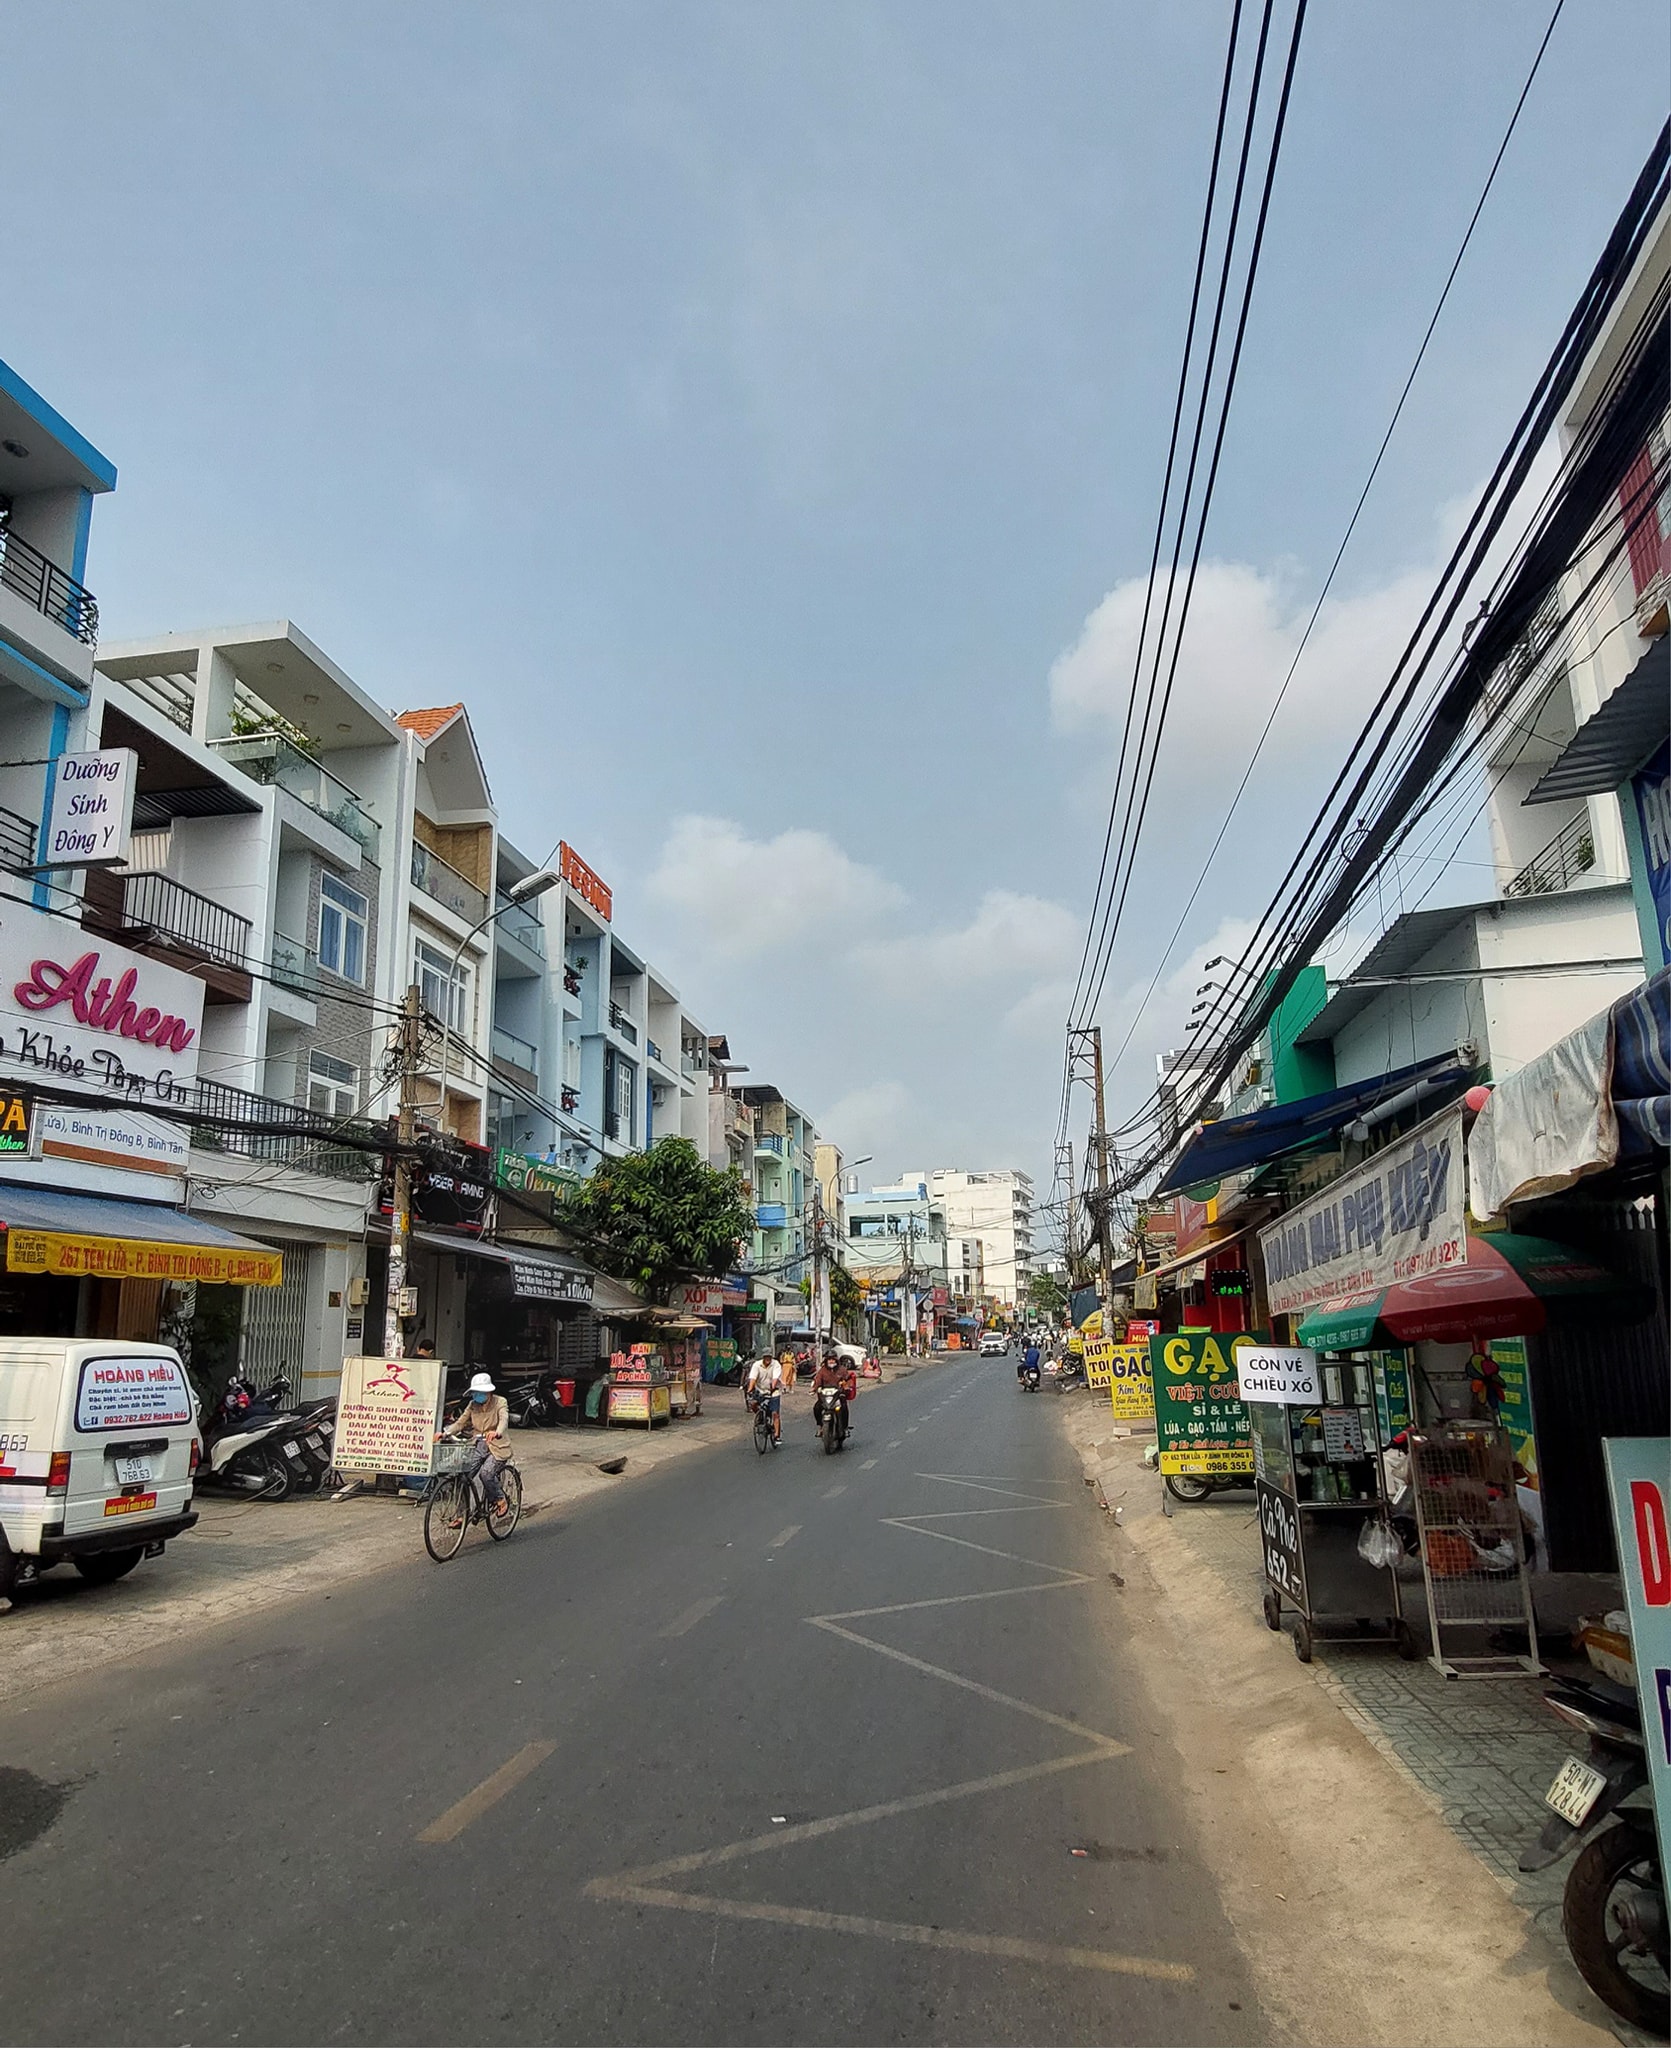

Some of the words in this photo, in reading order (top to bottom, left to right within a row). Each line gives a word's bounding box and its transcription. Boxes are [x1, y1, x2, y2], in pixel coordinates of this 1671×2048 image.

[62, 758, 120, 781] Dưỡng
[67, 792, 108, 816] Sinh
[54, 829, 96, 854] Đông
[103, 825, 114, 848] Y
[14, 951, 195, 1053] Athen
[17, 1027, 85, 1078] Khỏe
[93, 1049, 146, 1094] Tâm
[45, 1115, 67, 1133] ửa),
[72, 1121, 93, 1138] Bình
[95, 1125, 107, 1141] Trị
[110, 1128, 134, 1146] Đông
[136, 1133, 144, 1148] B,
[148, 1137, 167, 1152] Bình
[168, 1141, 184, 1155] Tân
[1265, 1223, 1310, 1286] HOÀNG
[1309, 1202, 1342, 1267] MAI
[1342, 1177, 1385, 1257] PHỤ
[1387, 1137, 1451, 1242] KIỆN
[59, 1245, 80, 1268] 267
[136, 1251, 144, 1272] P.
[214, 1258, 220, 1276] B
[684, 1284, 707, 1304] XÔI
[1085, 1341, 1110, 1357] HỚT
[1089, 1358, 1109, 1373] TÓ
[1249, 1355, 1281, 1371] CÒN
[1285, 1357, 1303, 1372] VÉ
[94, 1366, 145, 1384] HOÀNG
[1244, 1375, 1287, 1391] CHIỀU
[1117, 1383, 1135, 1395] Kim
[1166, 1382, 1205, 1403] VIỆT
[376, 1406, 397, 1414] SINH
[400, 1407, 425, 1416] ĐÔNG
[1193, 1402, 1206, 1416] SỈ
[1210, 1405, 1220, 1415] &
[1225, 1401, 1242, 1415] LẺ
[341, 1412, 356, 1420] GỘI
[412, 1417, 433, 1425] SINH
[349, 1421, 367, 1429] ĐAU
[406, 1424, 424, 1433] GÁY
[1164, 1419, 1180, 1435] LÚA
[1188, 1421, 1204, 1437] GẠO
[1210, 1416, 1228, 1433] TẤM
[387, 1433, 410, 1441] LƯNG
[399, 1441, 424, 1450] CHÂN
[1206, 1462, 1228, 1471] 0986
[1230, 1461, 1247, 1470] 355
[1267, 1545, 1290, 1591] 652
[1547, 1781, 1587, 1821] 128.44
